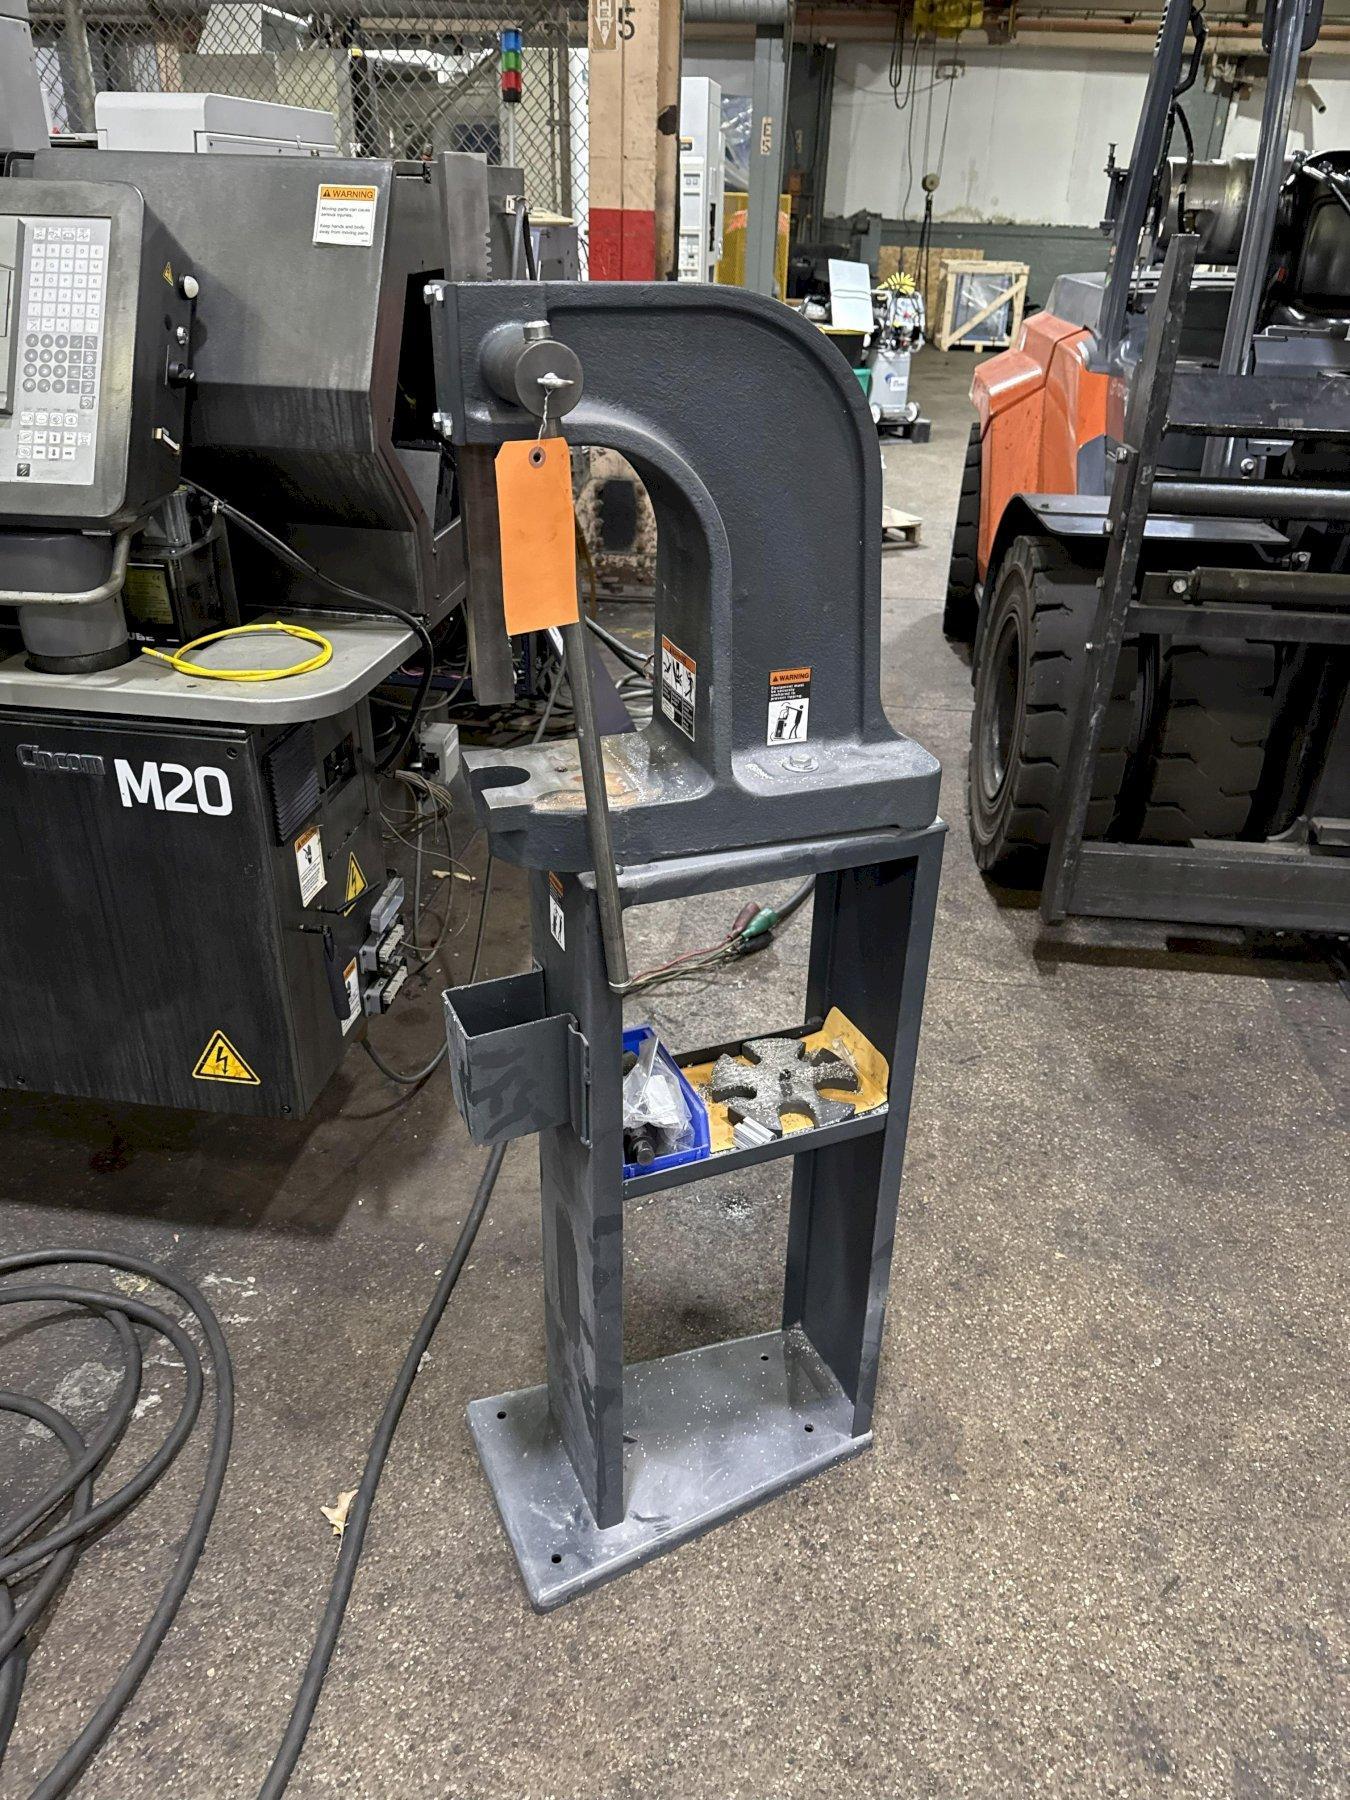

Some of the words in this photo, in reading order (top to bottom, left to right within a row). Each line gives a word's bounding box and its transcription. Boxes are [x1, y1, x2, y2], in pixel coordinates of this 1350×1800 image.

[618, 8, 635, 40] 5
[333, 190, 373, 198] WARNING
[780, 673, 809, 681] WARNING
[16, 744, 106, 775] Cincom
[114, 758, 233, 816] M20
